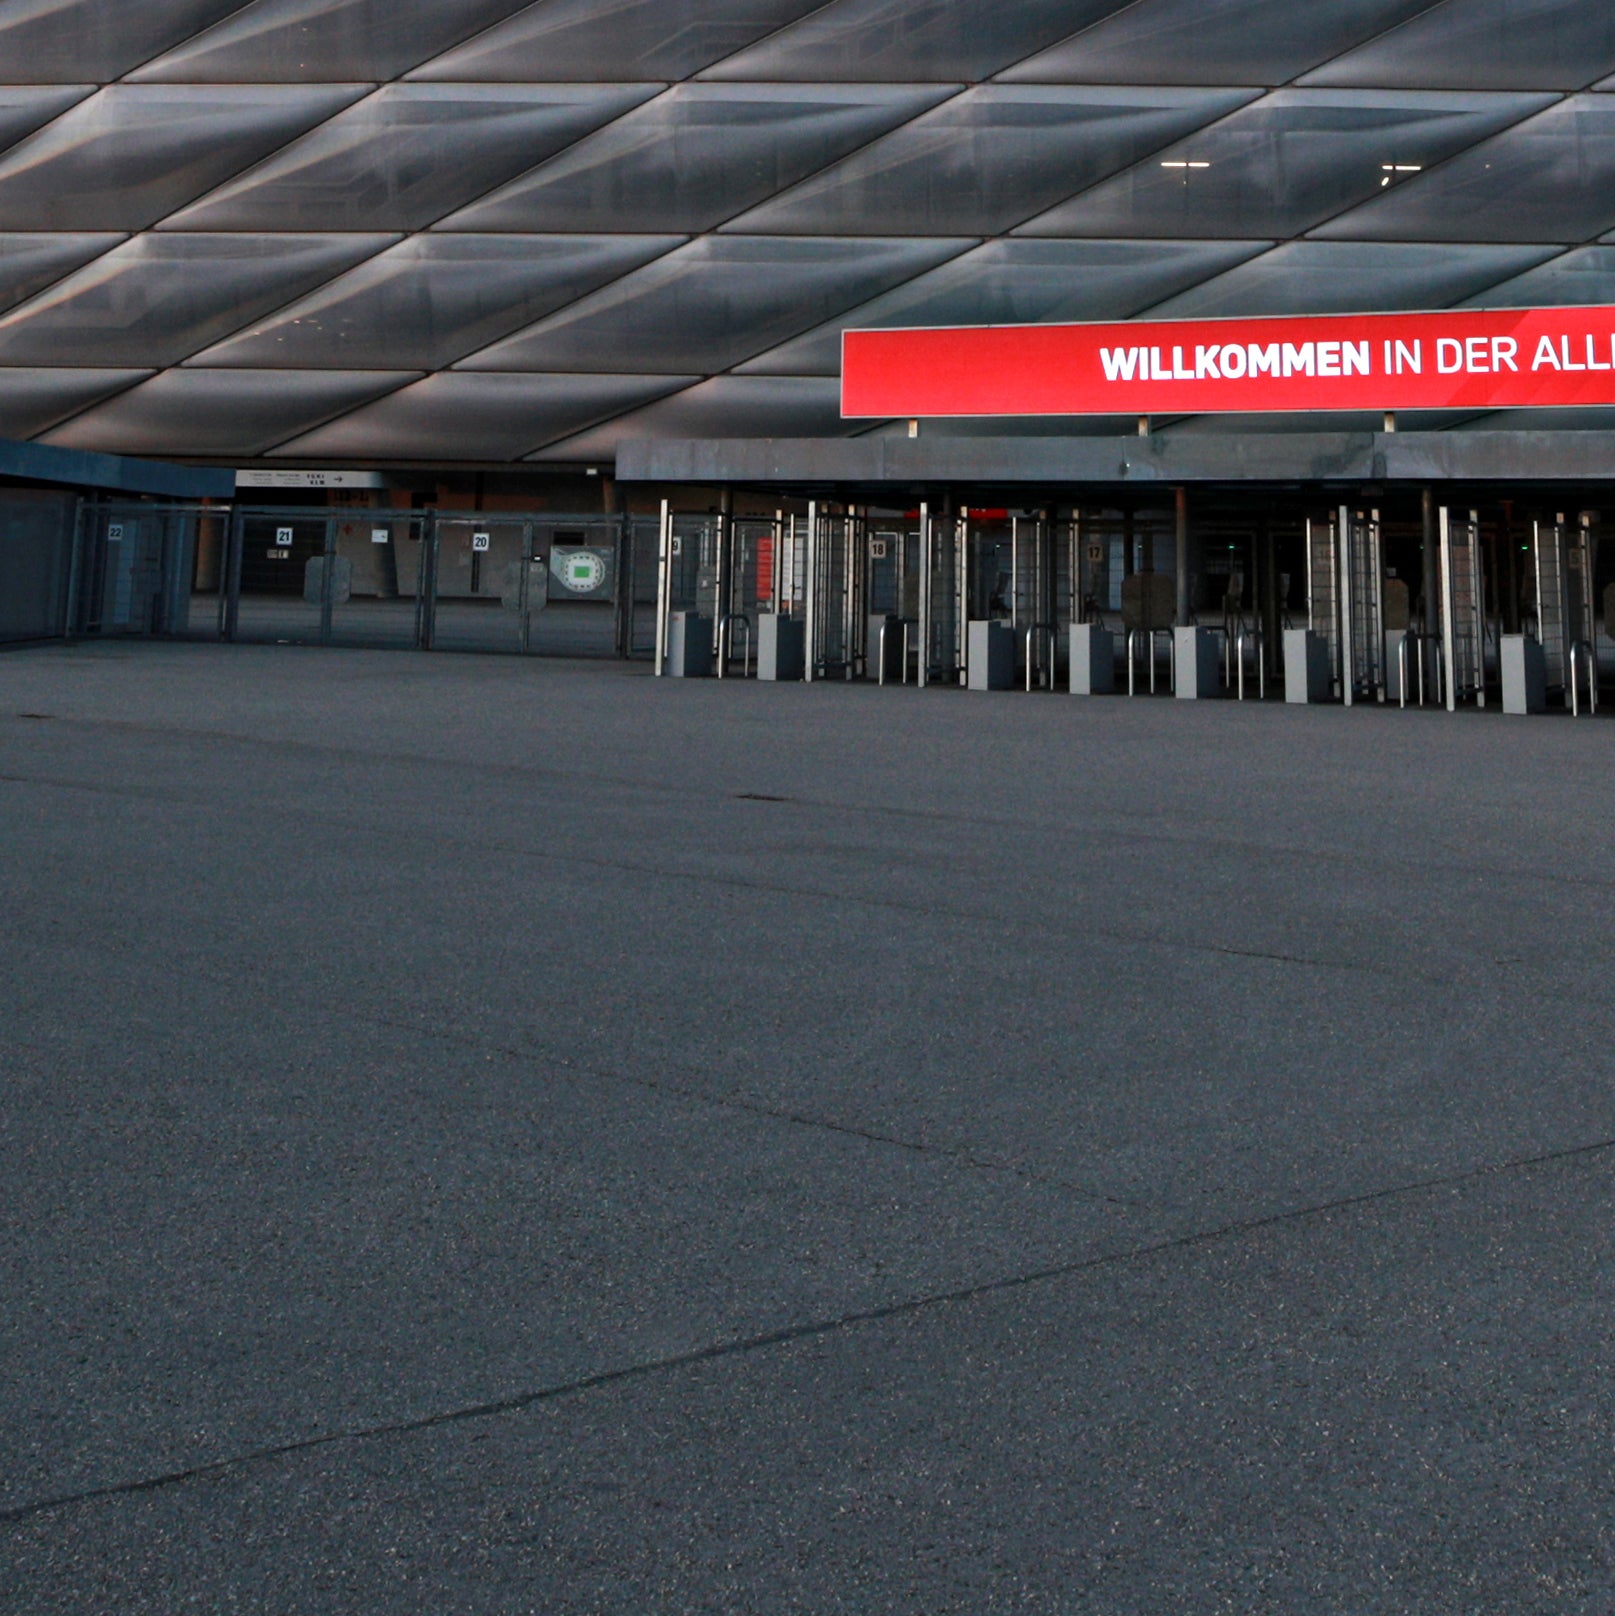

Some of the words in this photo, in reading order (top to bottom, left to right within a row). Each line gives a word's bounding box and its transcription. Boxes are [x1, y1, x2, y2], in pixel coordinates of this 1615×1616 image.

[1099, 340, 1371, 381] WILLKOMMEN
[1384, 339, 1421, 375] IN
[1437, 336, 1518, 374] DER
[110, 527, 122, 537] 22
[279, 530, 290, 542] 21
[475, 536, 487, 548] 20
[872, 544, 883, 555] 18
